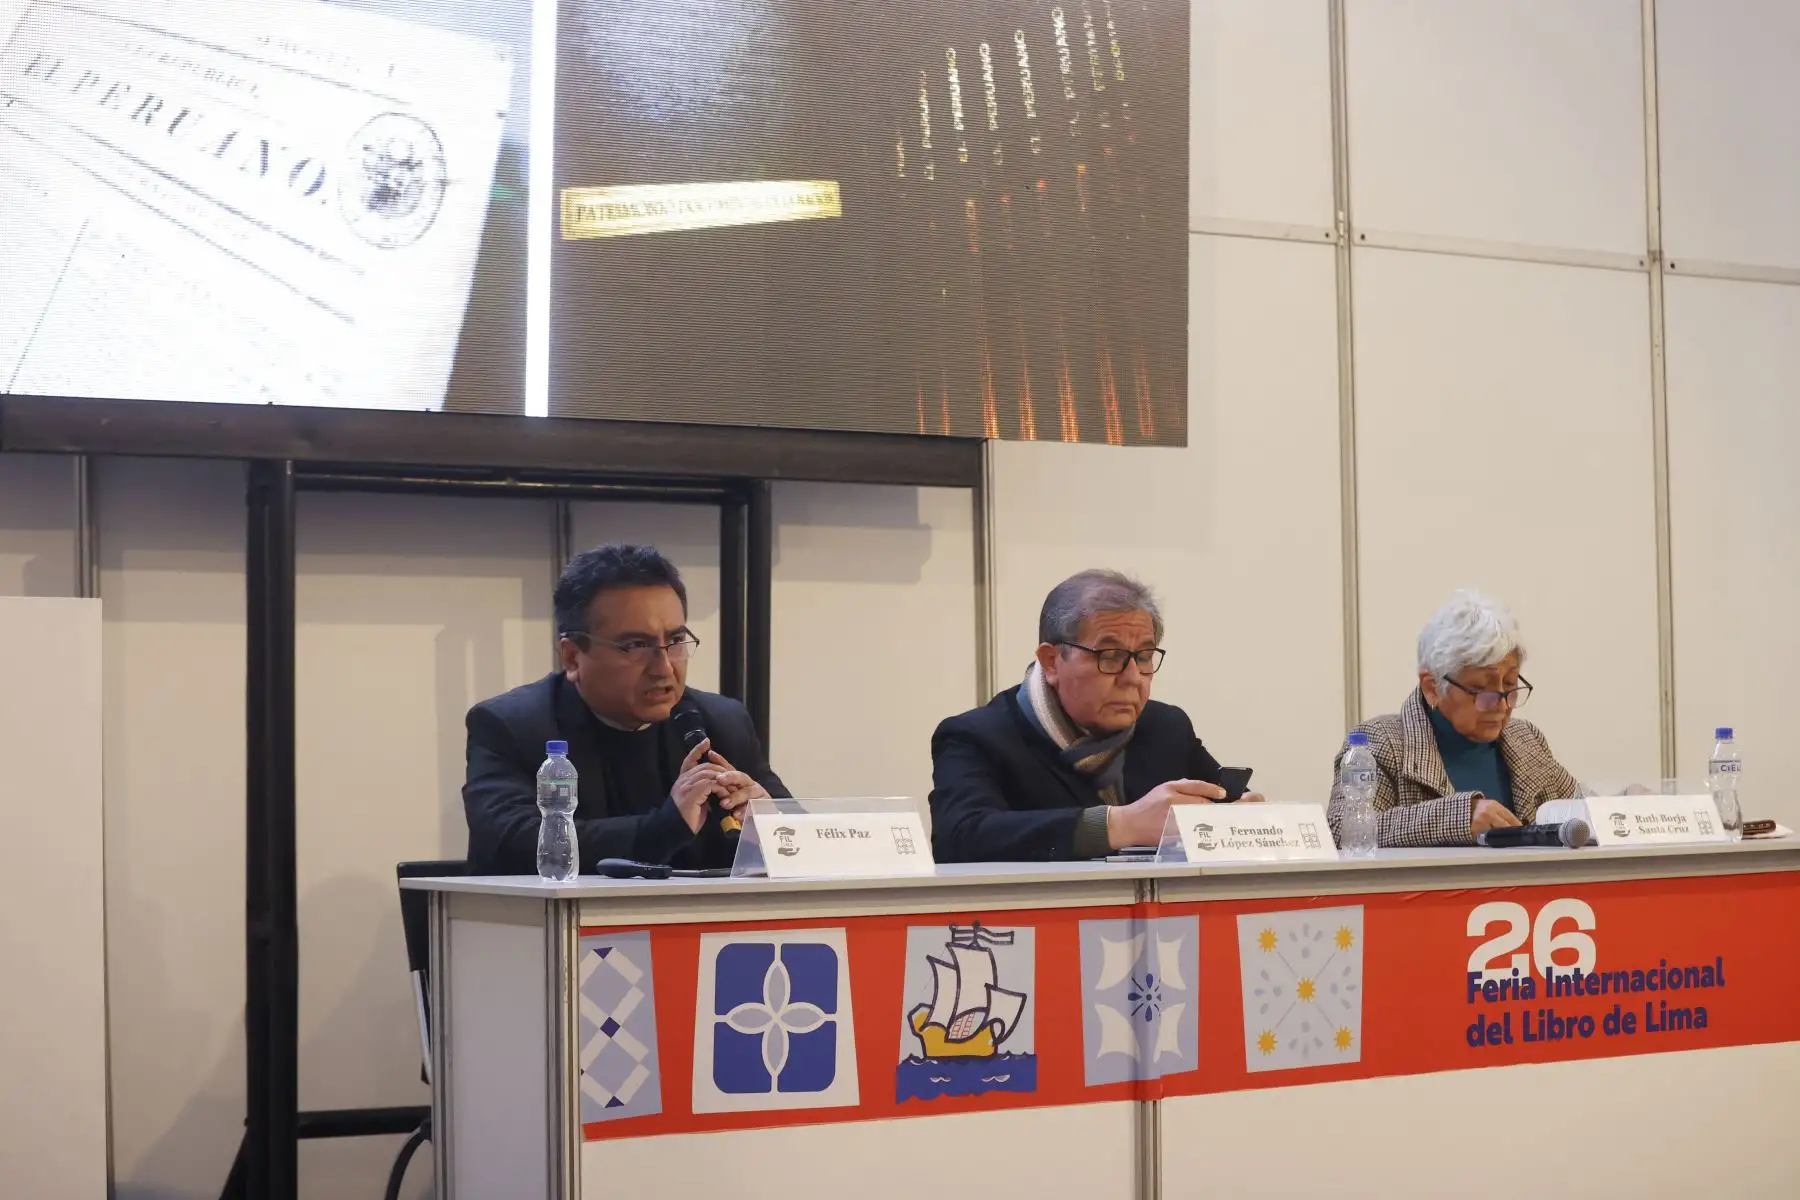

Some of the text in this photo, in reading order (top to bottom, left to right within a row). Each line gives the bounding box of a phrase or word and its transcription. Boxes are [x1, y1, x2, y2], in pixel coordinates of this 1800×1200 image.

[1635, 814, 1687, 826] Ruth Borja
[816, 827, 872, 839] Félix Paz
[1229, 825, 1284, 837] Fernando
[1638, 824, 1690, 835] Santa Cruz
[779, 835, 793, 843] FIL
[1220, 837, 1253, 850] López
[1466, 897, 1597, 988] 26
[1467, 956, 1726, 1004] Feria Internacional
[1466, 1000, 1708, 1047] del Libro de Lima
